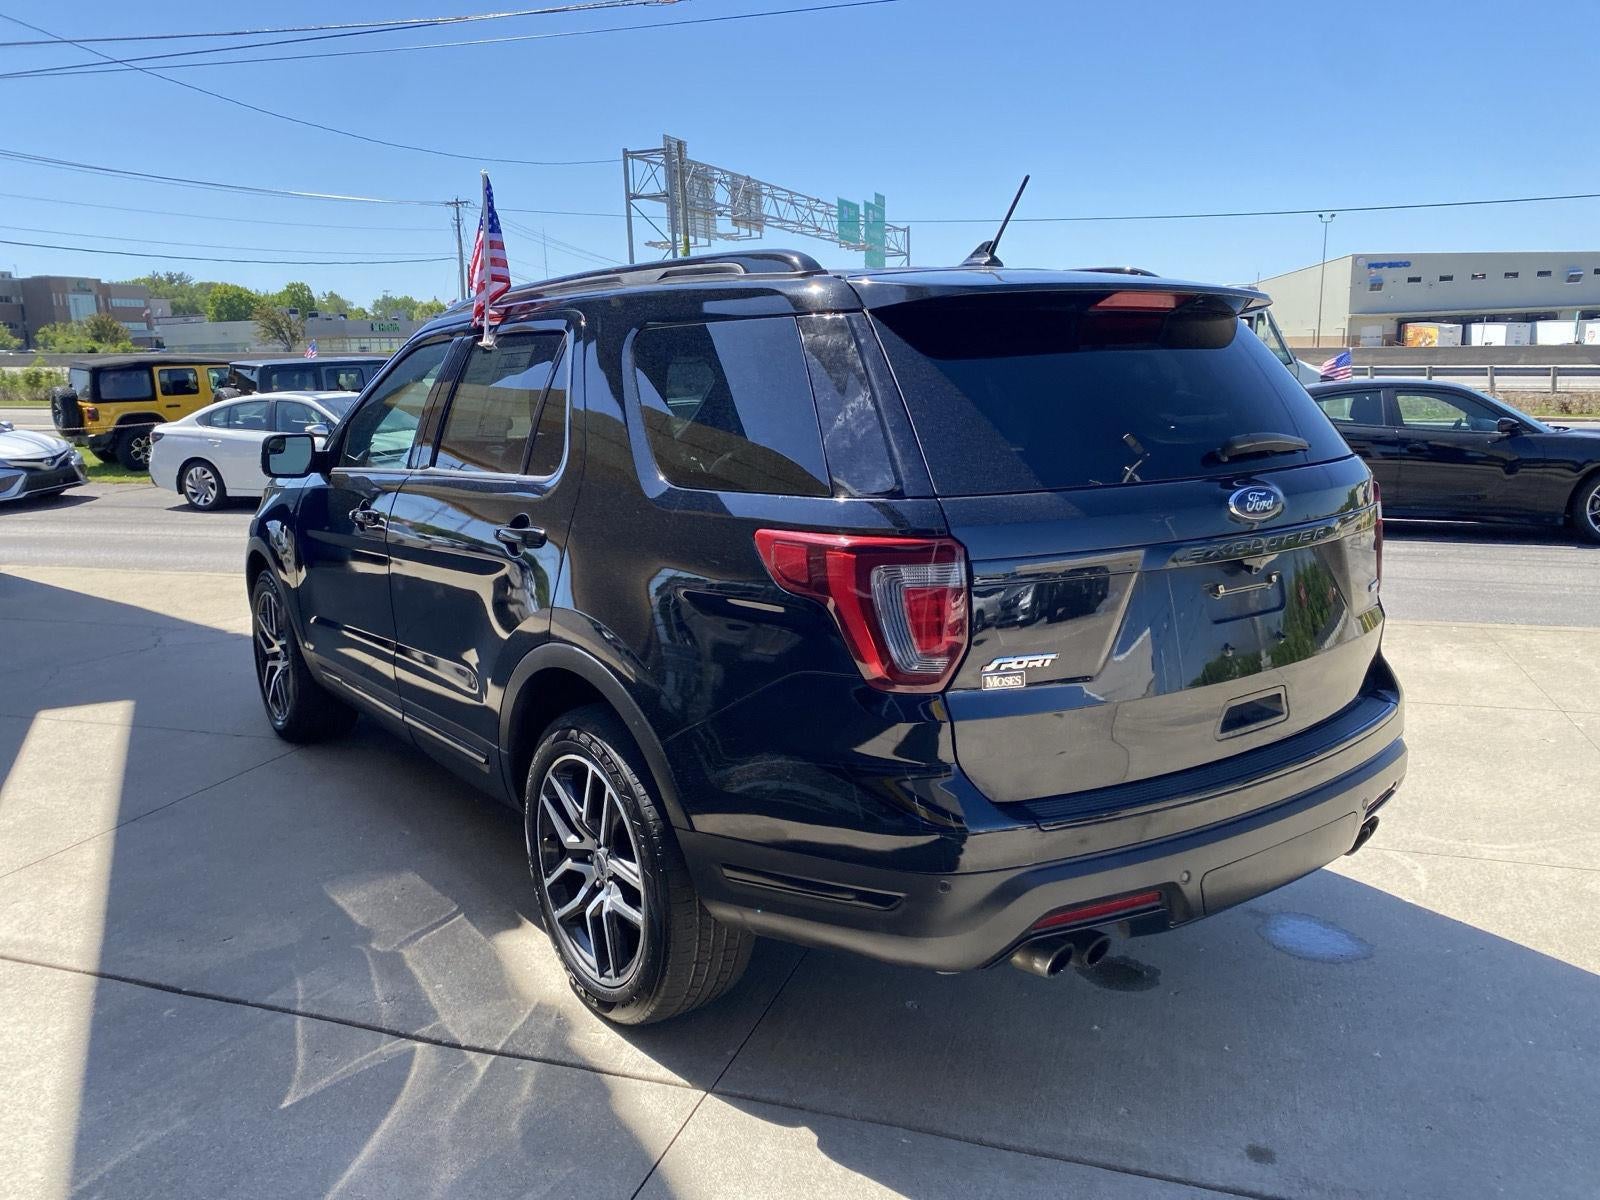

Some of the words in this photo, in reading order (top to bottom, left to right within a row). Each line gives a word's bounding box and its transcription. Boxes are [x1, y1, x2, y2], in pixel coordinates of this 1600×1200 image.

[1246, 491, 1274, 512] Ford
[1189, 527, 1327, 559] EXPLORER
[981, 653, 1059, 672] SPORT
